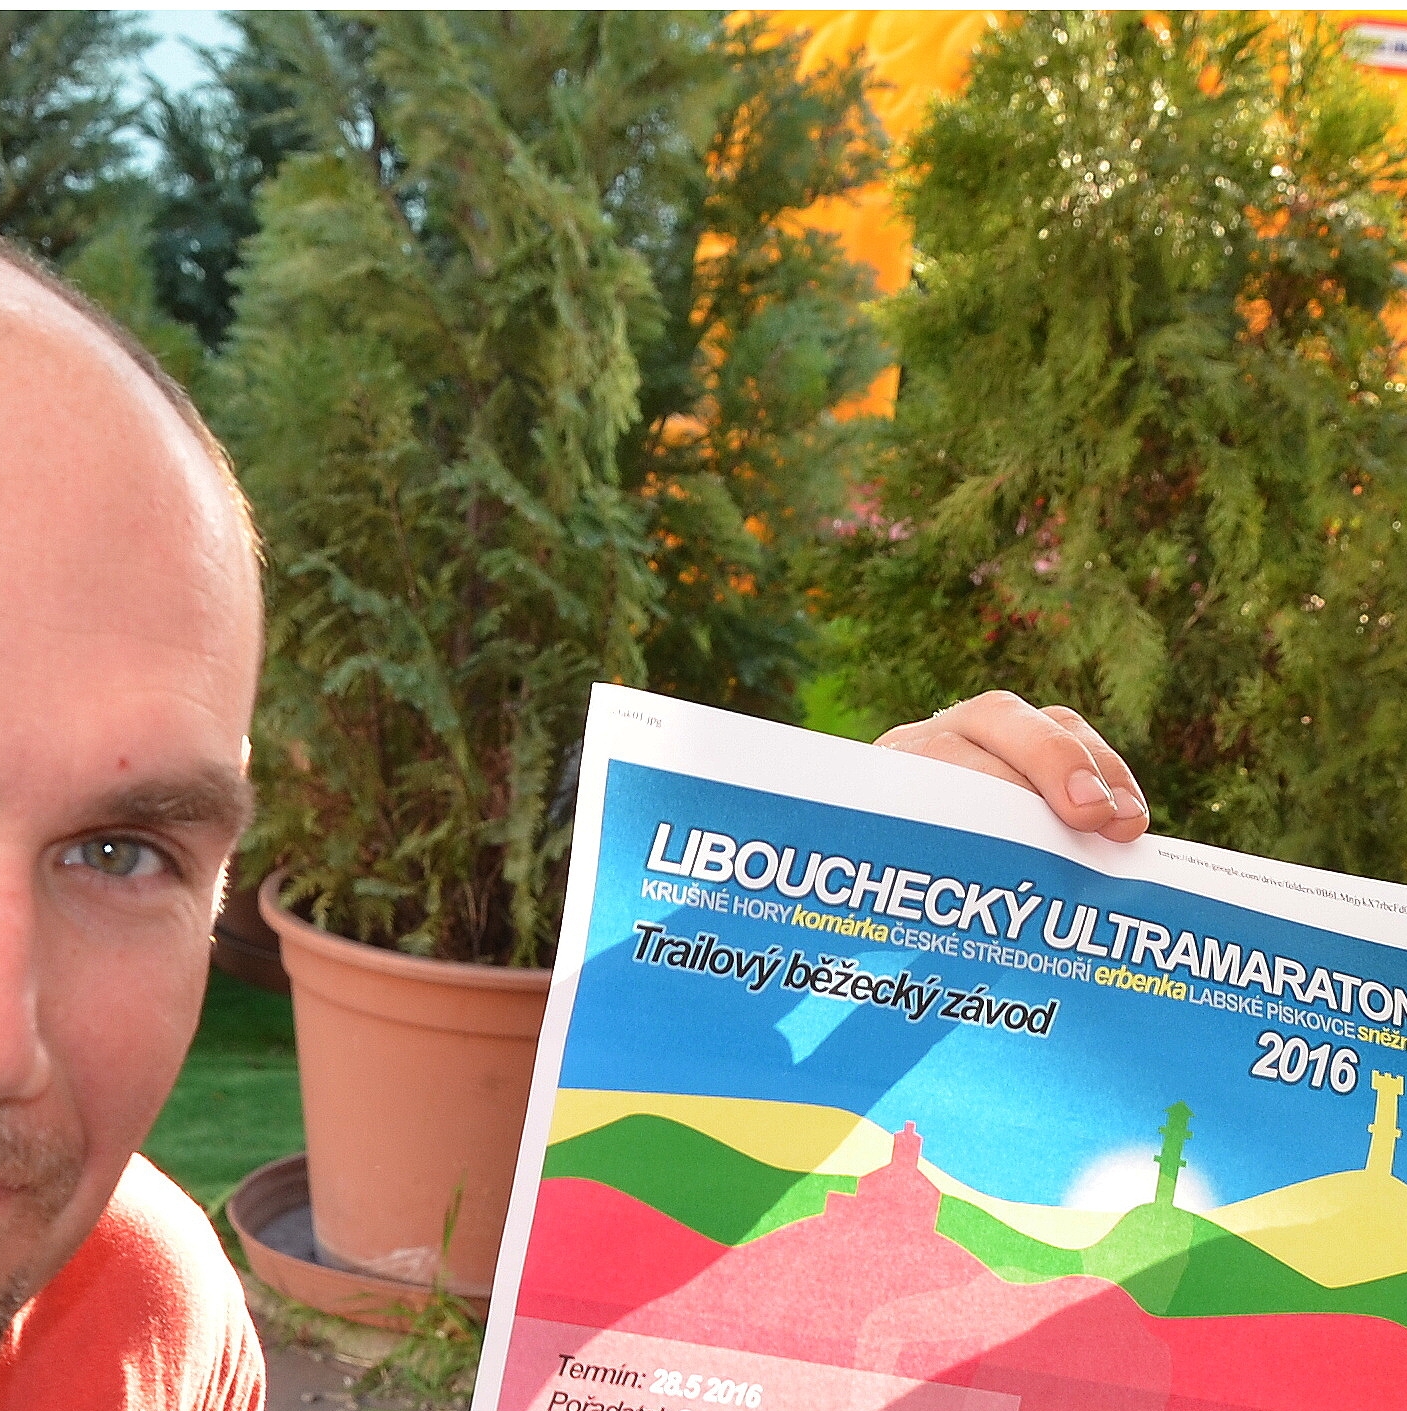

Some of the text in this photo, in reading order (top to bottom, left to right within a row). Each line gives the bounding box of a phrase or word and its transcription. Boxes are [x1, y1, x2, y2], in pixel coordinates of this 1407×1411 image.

[647, 822, 1043, 940] LIBOUCHECKÝ
[634, 923, 1059, 1037] Trailový běžecký závod
[642, 878, 730, 914] KRUŠNÉ
[732, 896, 793, 924] HORY
[792, 903, 889, 942] komárka
[890, 920, 960, 956] ČESKÉ
[961, 935, 1093, 983] STŘEDOHOŘÍ
[1094, 964, 1187, 1001] erbenka
[1188, 985, 1264, 1019] LABSKÉ
[1266, 1000, 1356, 1040] PÍSKOVCE
[1250, 1031, 1360, 1094] 2016
[556, 1353, 764, 1409] Termín: 28.5 2016
